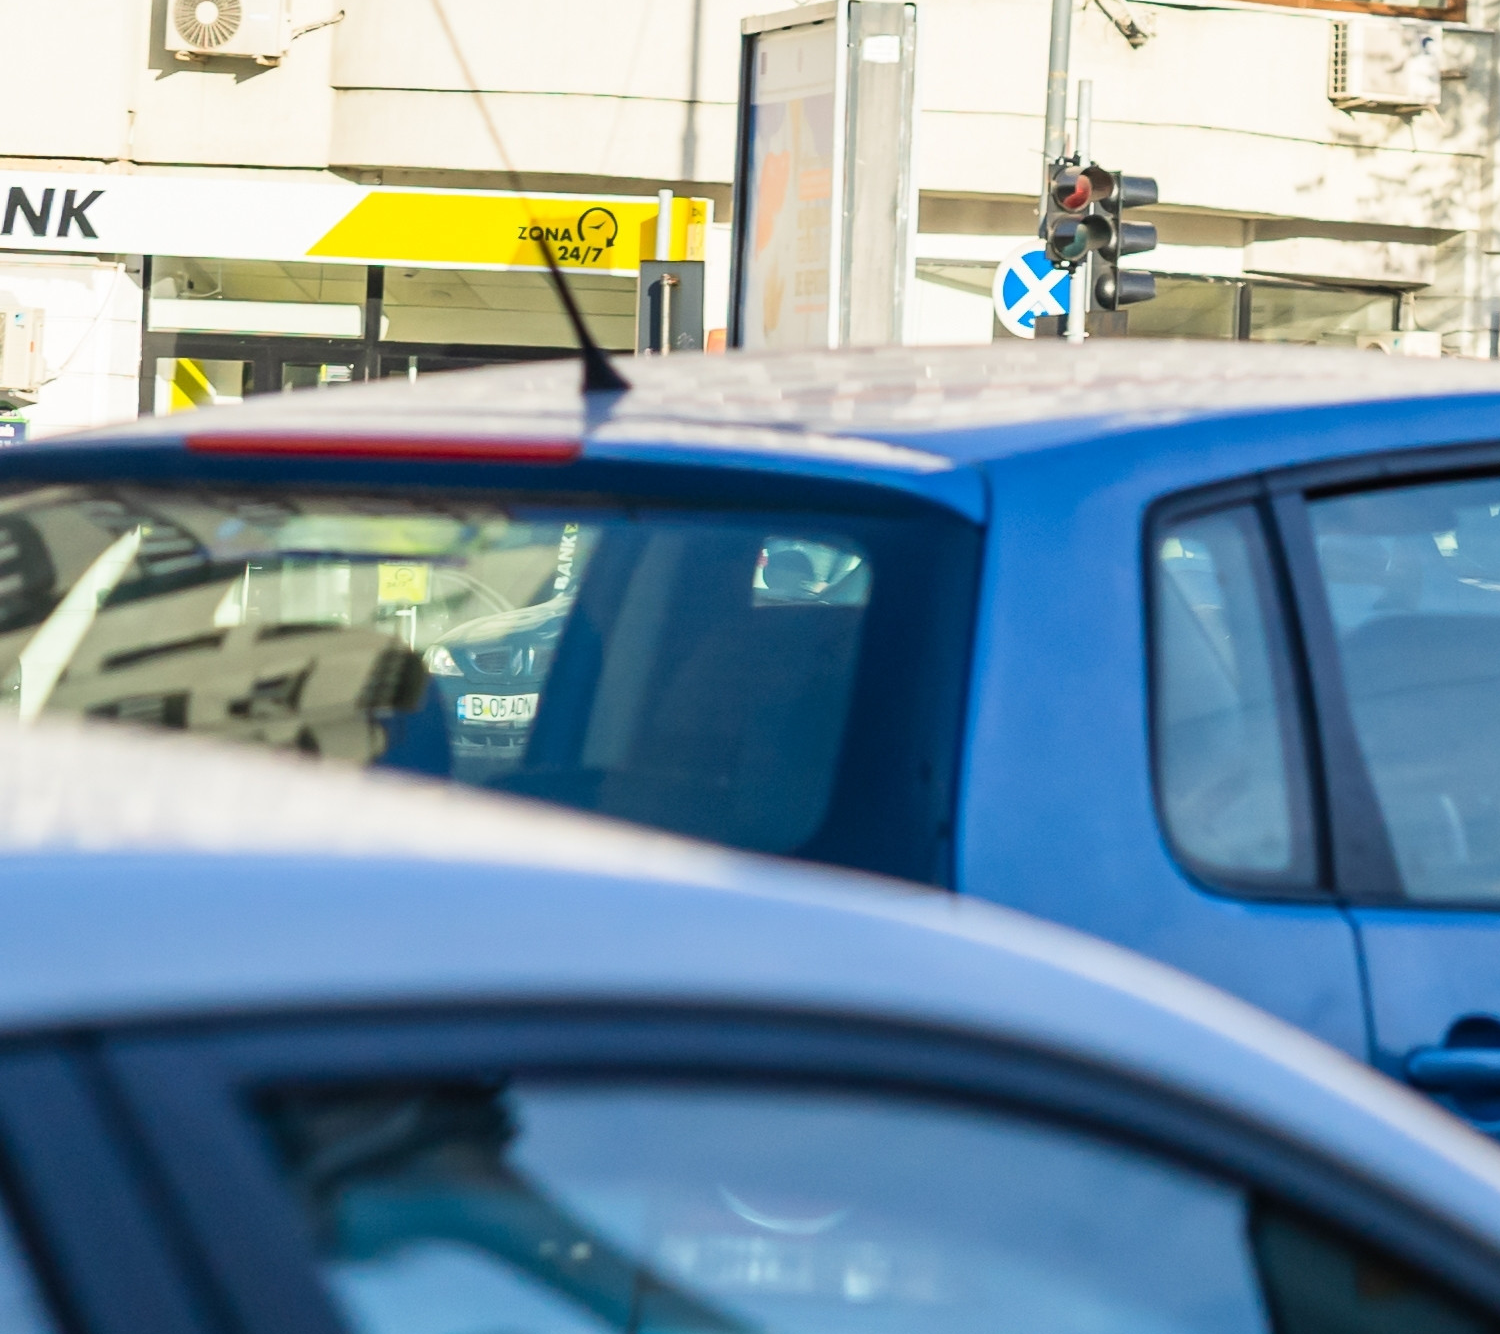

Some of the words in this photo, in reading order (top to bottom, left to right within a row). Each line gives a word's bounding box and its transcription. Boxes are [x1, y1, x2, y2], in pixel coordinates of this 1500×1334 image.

[518, 226, 573, 242] ZONA
[557, 245, 604, 265] 24/7
[553, 534, 578, 590] BANK
[471, 696, 483, 716] B
[489, 698, 507, 718] 05
